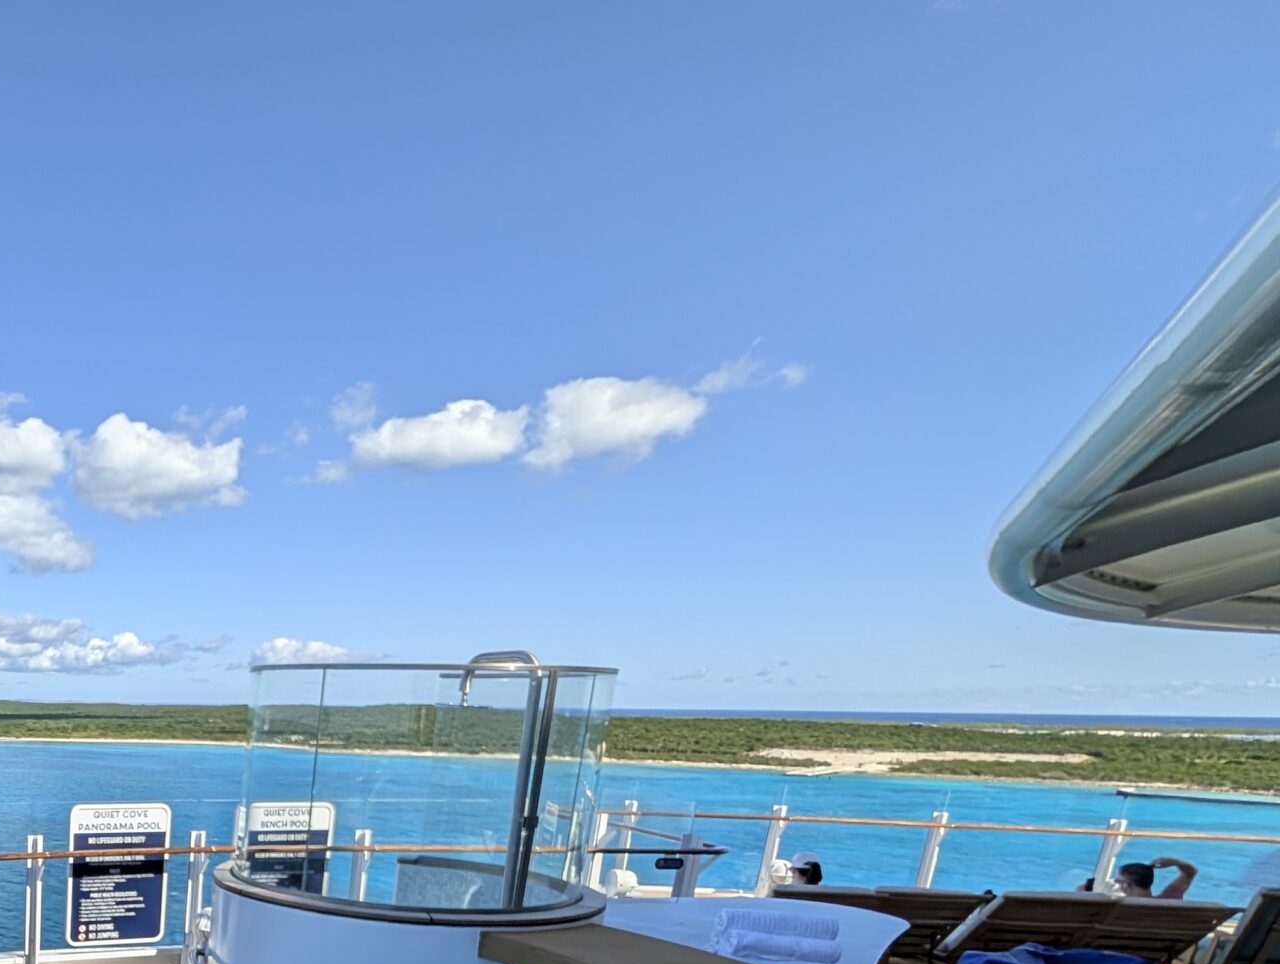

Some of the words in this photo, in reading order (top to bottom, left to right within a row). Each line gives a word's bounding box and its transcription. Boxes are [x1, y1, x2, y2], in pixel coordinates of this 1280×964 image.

[93, 810, 120, 819] QUIET
[122, 810, 149, 818] COVE
[263, 808, 286, 817] QUIET
[78, 822, 135, 831] PANORAMA
[137, 821, 162, 830] POOL
[260, 820, 288, 828] BENCH
[87, 837, 97, 845] NO
[97, 836, 123, 845] LIFEGUARD
[123, 836, 132, 844] ON
[132, 836, 146, 844] DUTY
[97, 923, 114, 931] DIVING
[88, 932, 97, 940] NO
[96, 931, 120, 939] JUMPING
